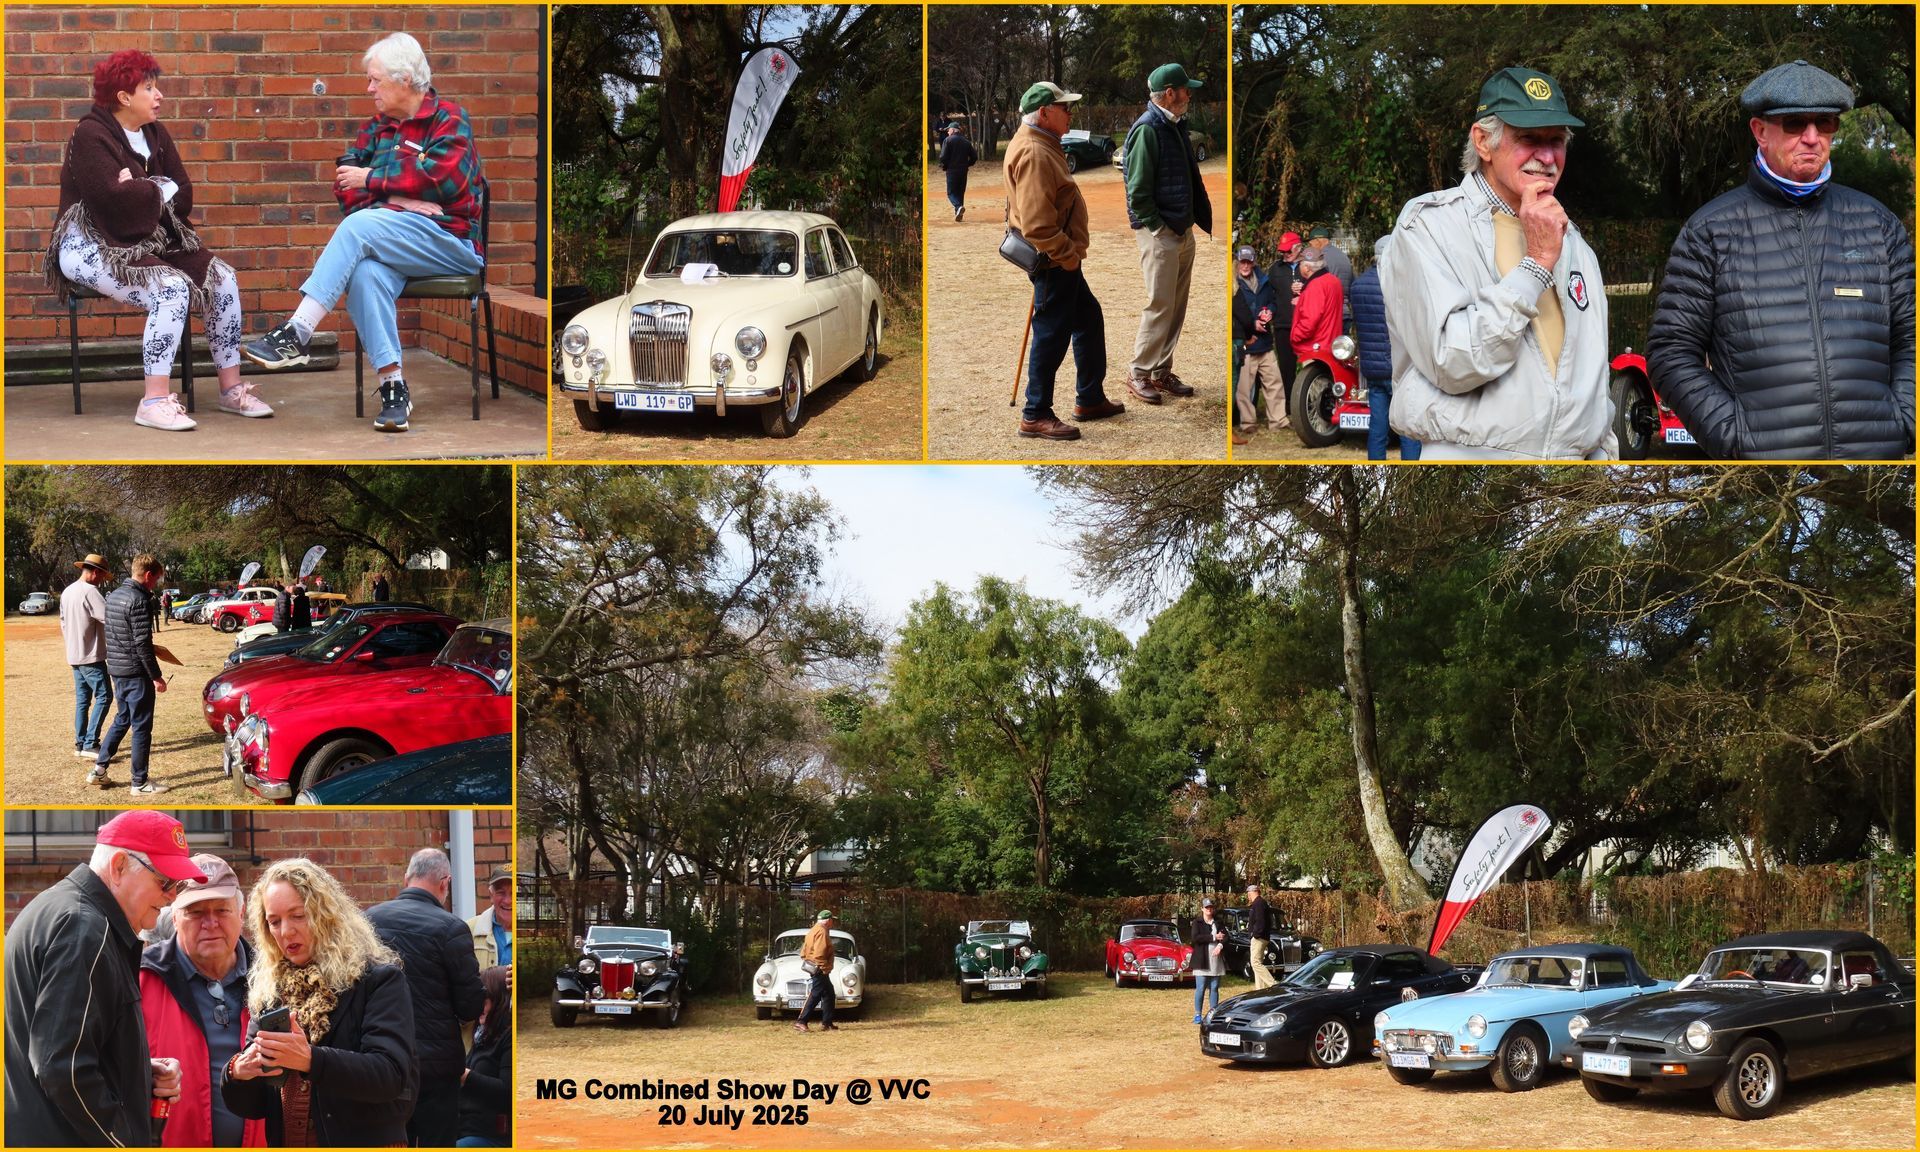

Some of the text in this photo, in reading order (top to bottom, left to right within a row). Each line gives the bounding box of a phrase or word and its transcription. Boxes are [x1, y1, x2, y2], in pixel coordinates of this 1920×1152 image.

[1526, 79, 1551, 99] MG
[617, 393, 692, 410] LWD 119 GP
[1667, 430, 1695, 442] MEGA
